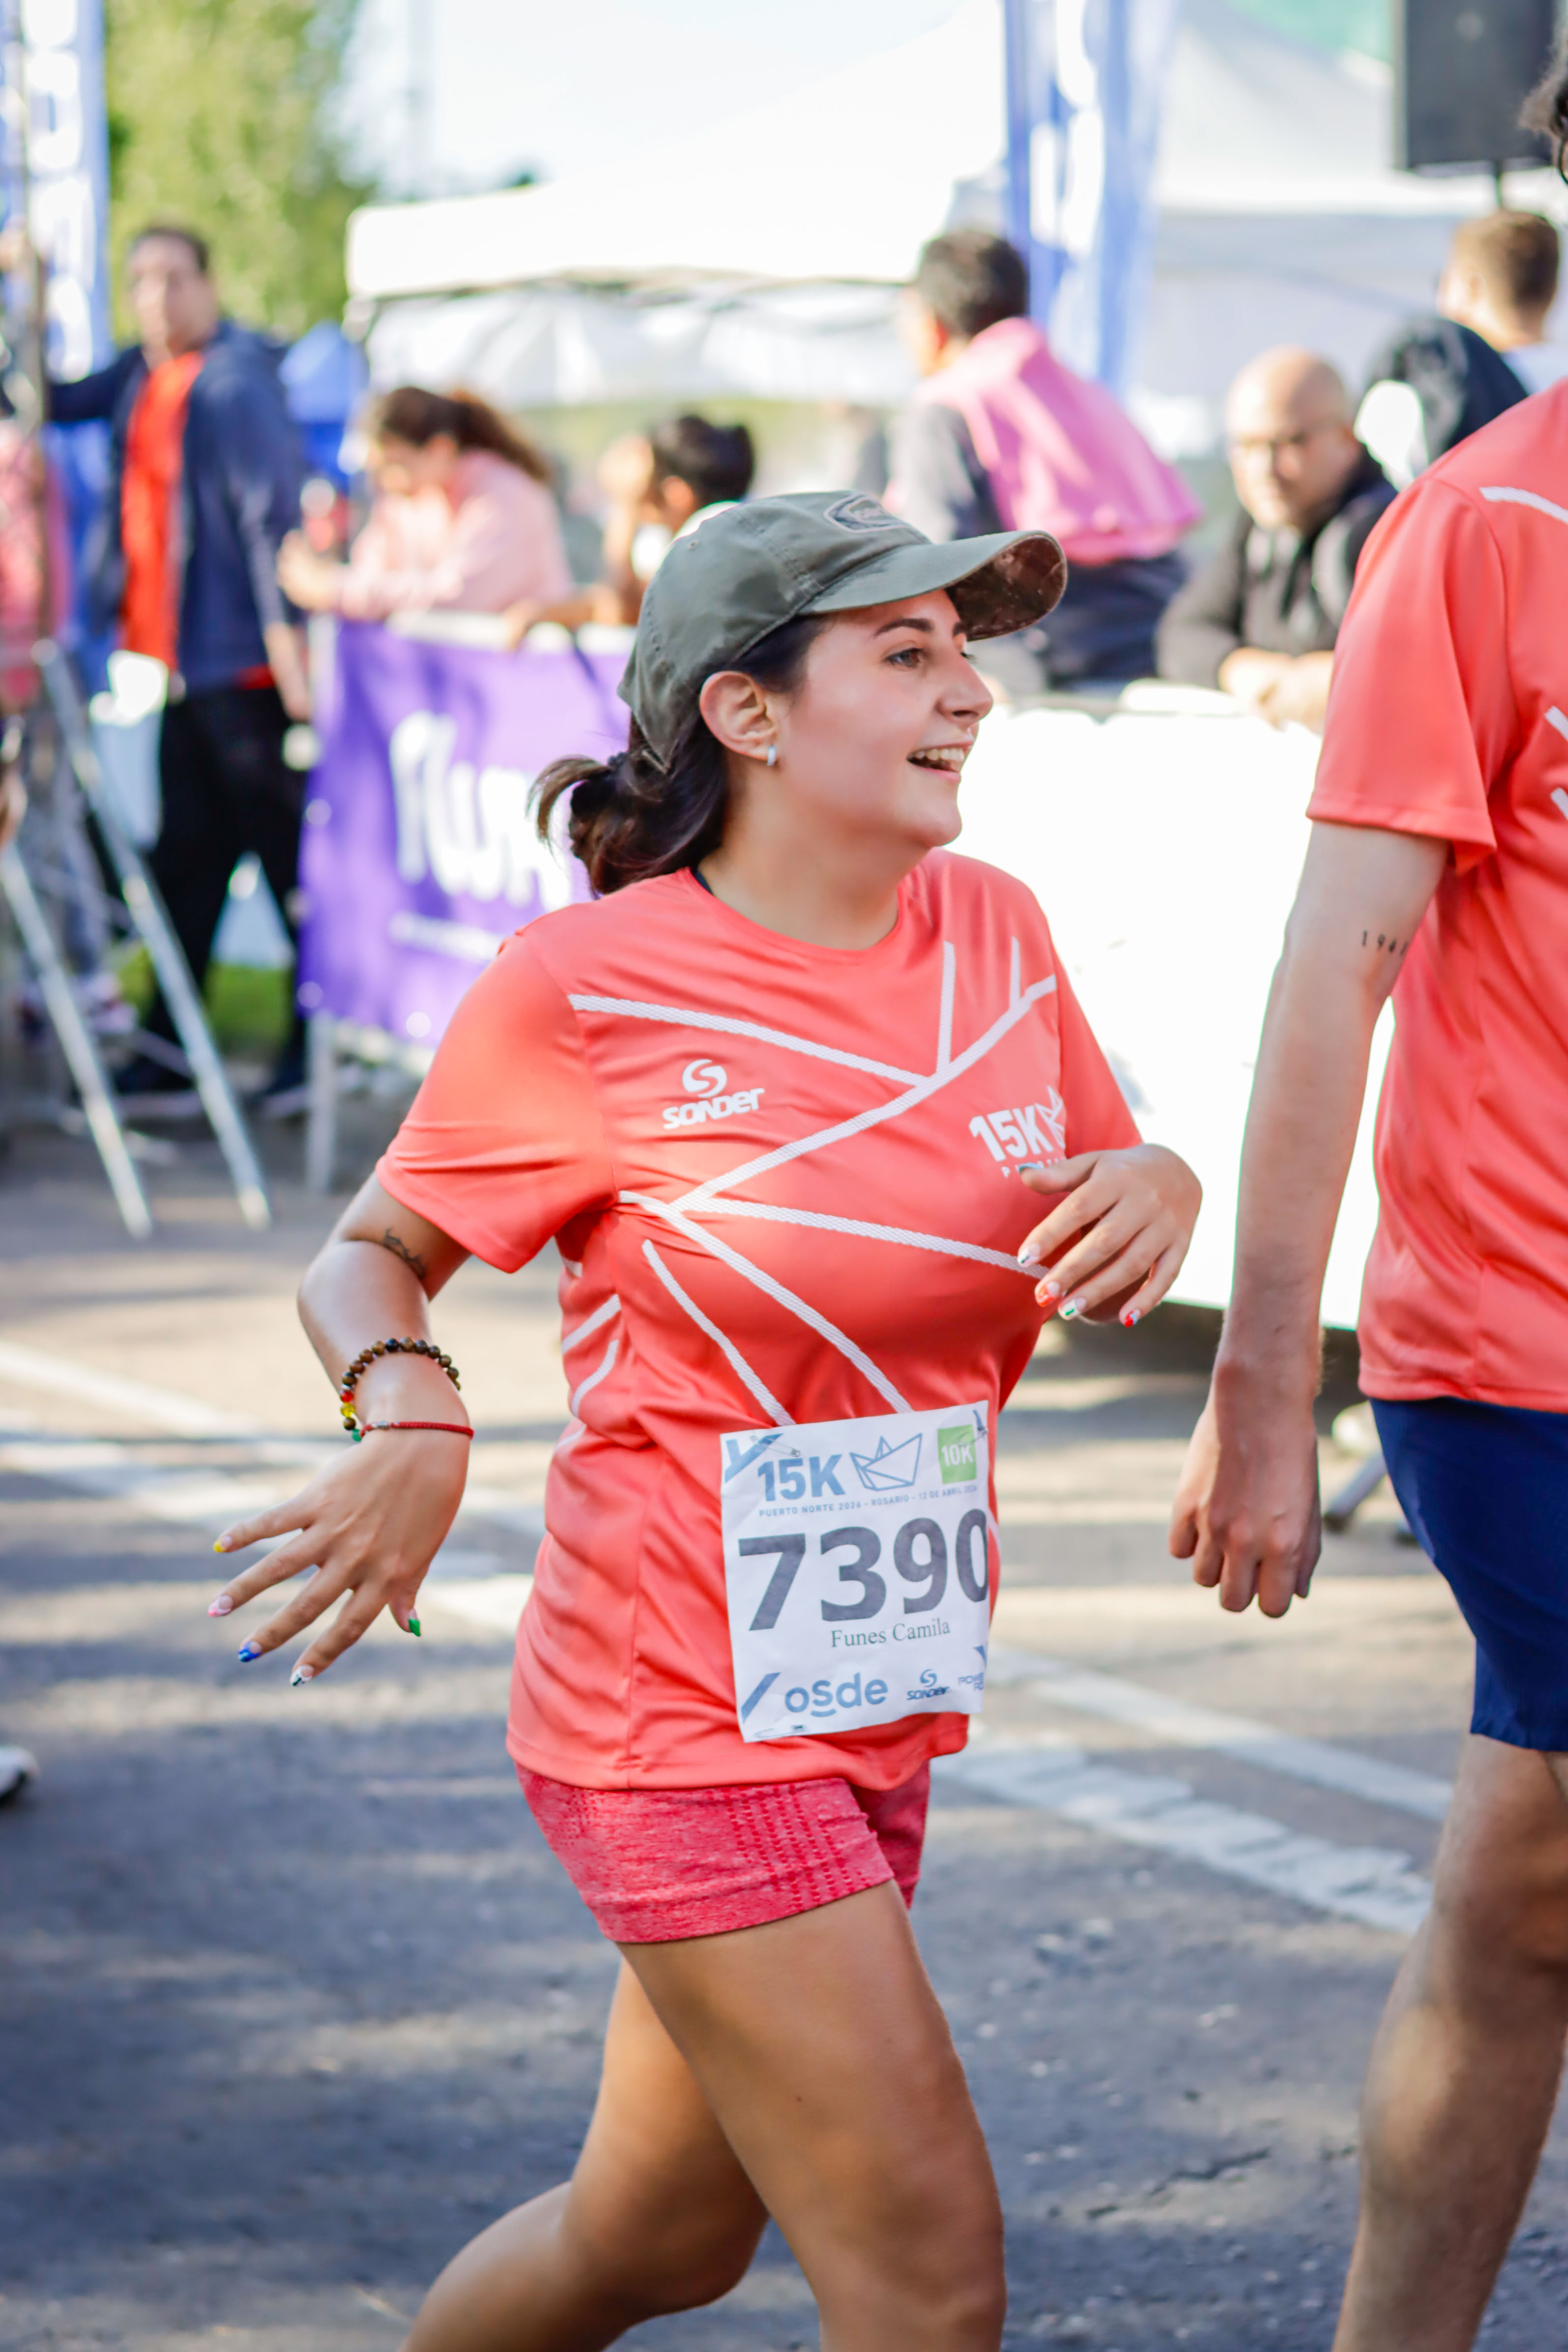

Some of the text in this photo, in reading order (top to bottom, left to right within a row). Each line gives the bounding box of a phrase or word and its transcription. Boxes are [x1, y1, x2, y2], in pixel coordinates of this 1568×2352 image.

[968, 1105, 1054, 1162] 15K
[941, 1443, 974, 1467] 10K
[757, 1453, 846, 1501] 15K
[759, 1506, 798, 1517] PUERTO
[801, 1503, 834, 1513] NORTE
[838, 1501, 861, 1510] 2026
[871, 1494, 910, 1506] ROSARIO
[930, 1490, 939, 1498] DE
[942, 1486, 962, 1496] ABRIL
[738, 1508, 989, 1631] 7390
[830, 1617, 951, 1647] Funes Camila
[784, 1672, 888, 1715] osde
